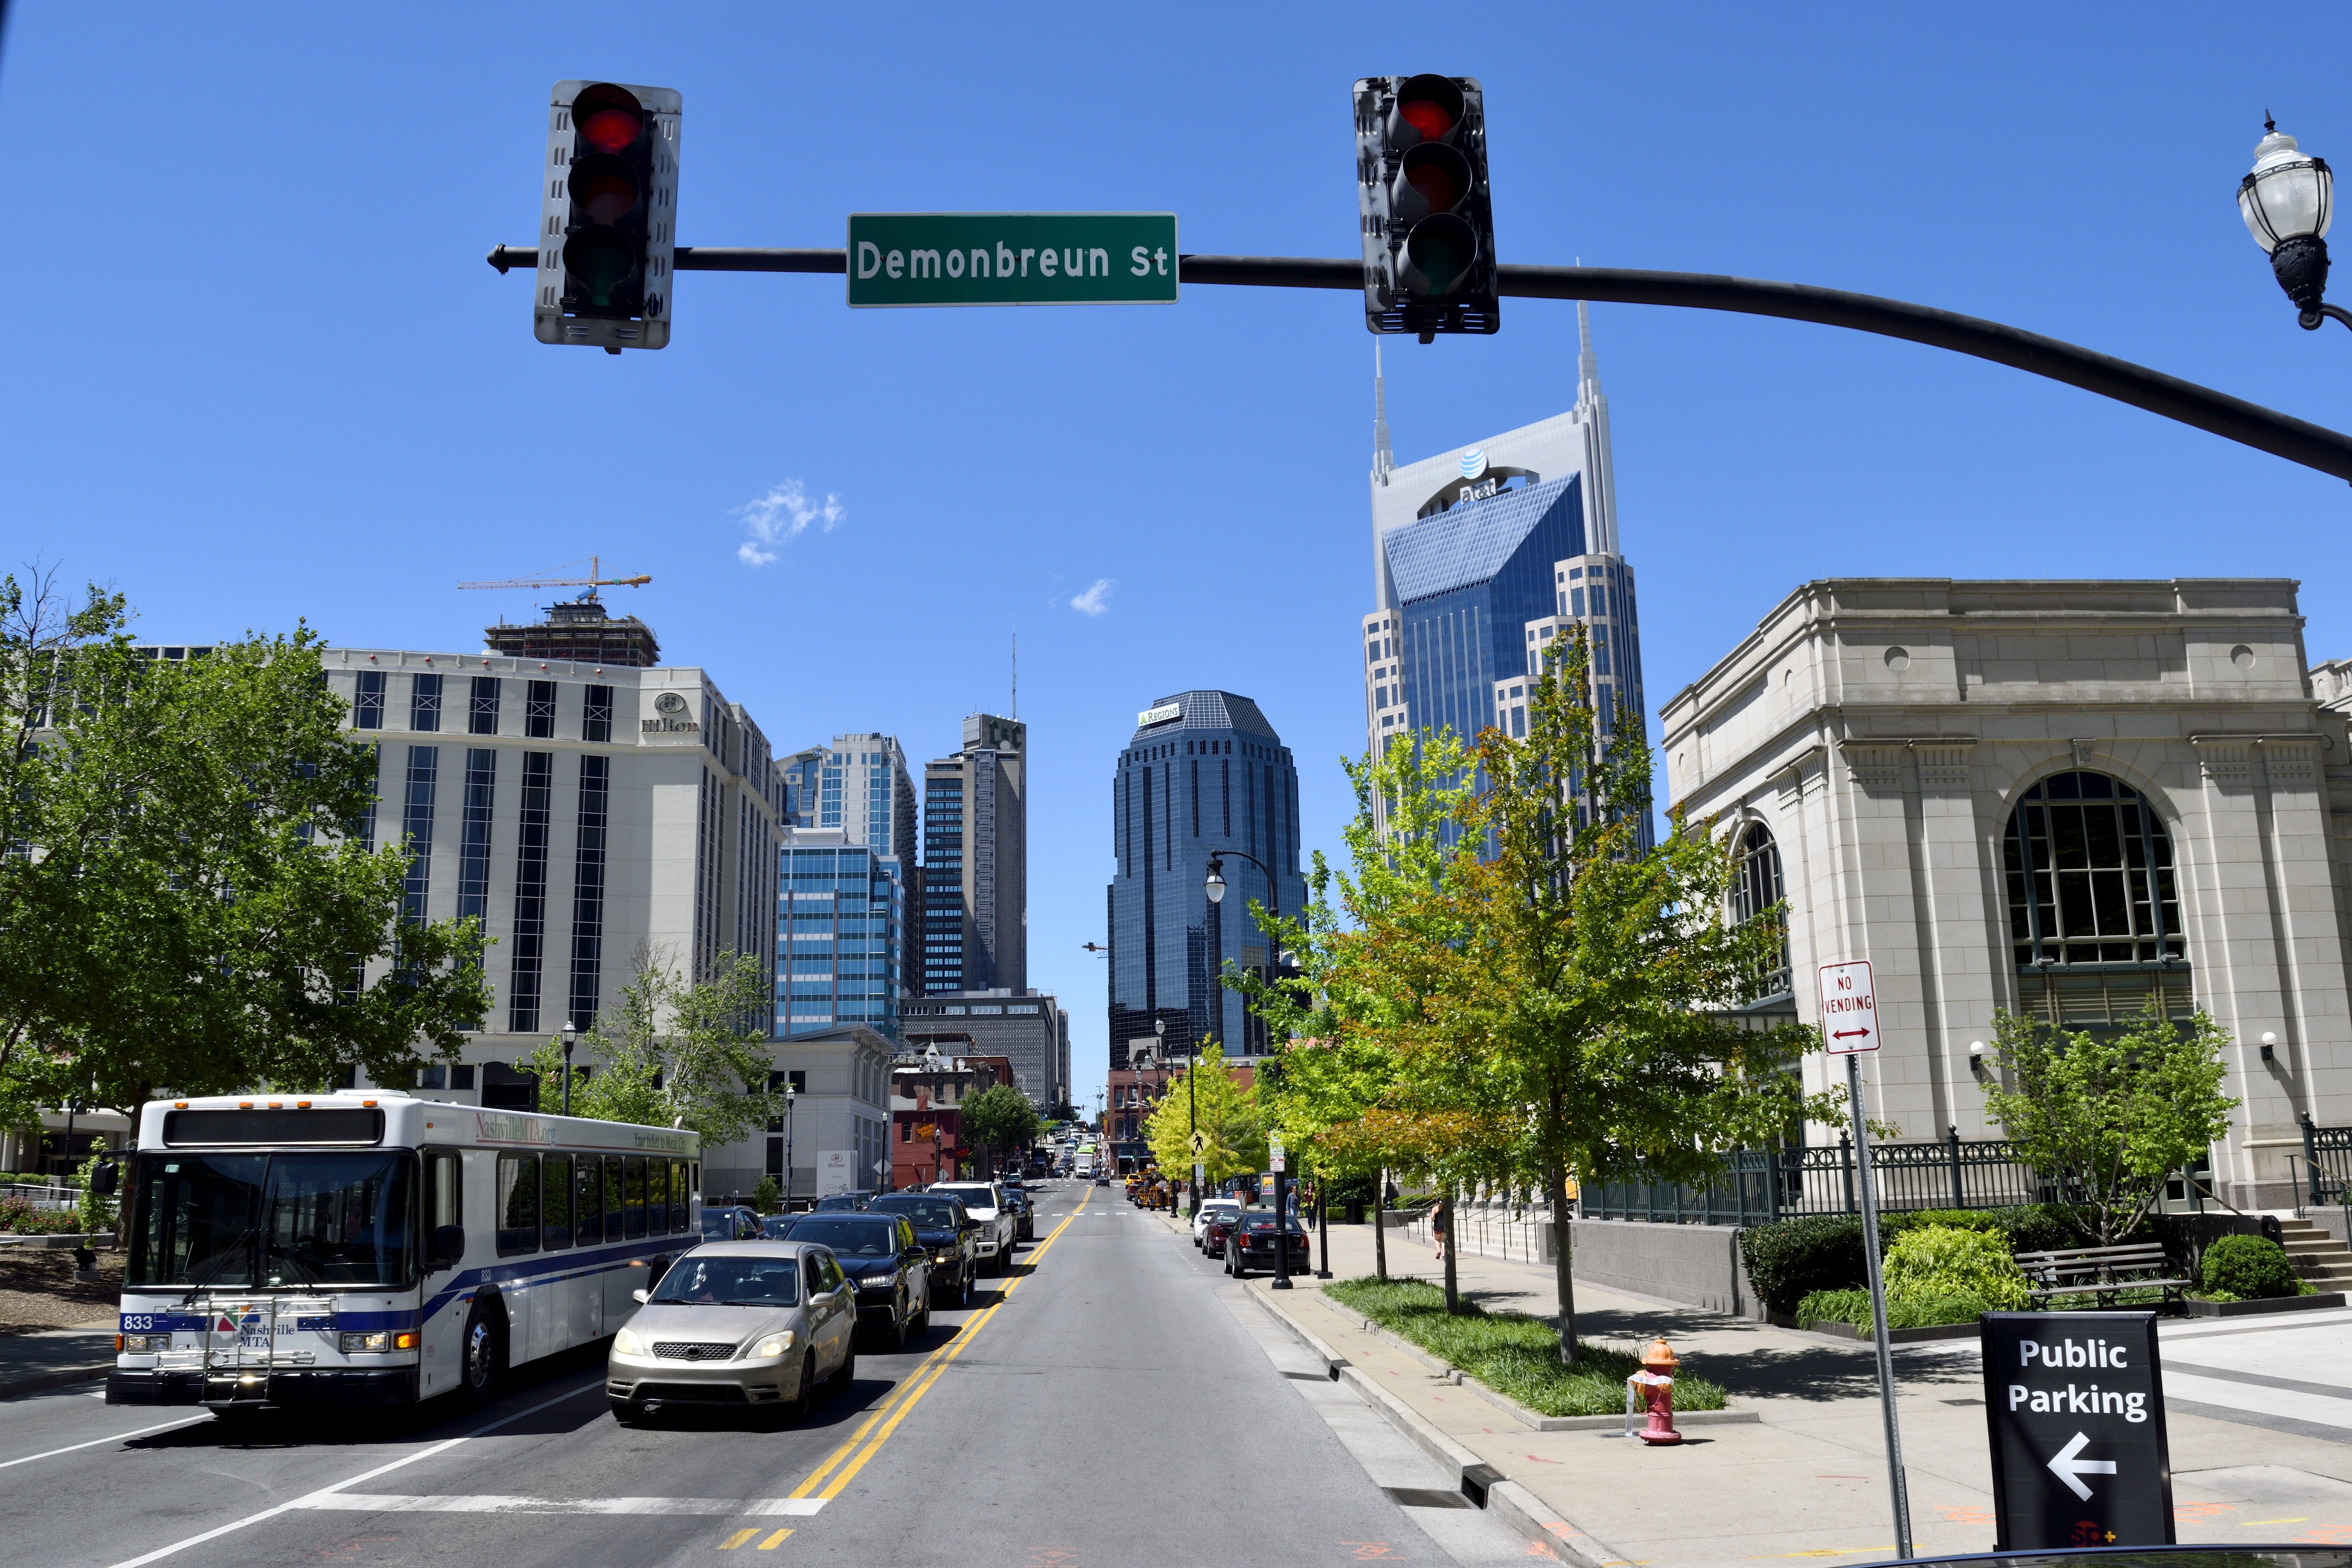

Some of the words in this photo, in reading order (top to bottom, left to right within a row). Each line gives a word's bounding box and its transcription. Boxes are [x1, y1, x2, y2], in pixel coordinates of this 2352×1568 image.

[858, 240, 1109, 279] Demonbreun
[1130, 246, 1168, 276] St
[641, 718, 699, 733] Hilton
[1837, 976, 1851, 991] NO
[1825, 995, 1871, 1014] VENDING
[476, 1112, 556, 1149] NashvilleMTA.org
[634, 1132, 646, 1147] Your
[646, 1133, 659, 1149] ticket
[660, 1137, 665, 1149] to
[666, 1135, 678, 1150] Music
[481, 1269, 491, 1282] 833
[124, 1316, 152, 1330] 833
[240, 1337, 270, 1347] MTA
[2020, 1339, 2127, 1368] Public
[2009, 1384, 2147, 1423] Parking
